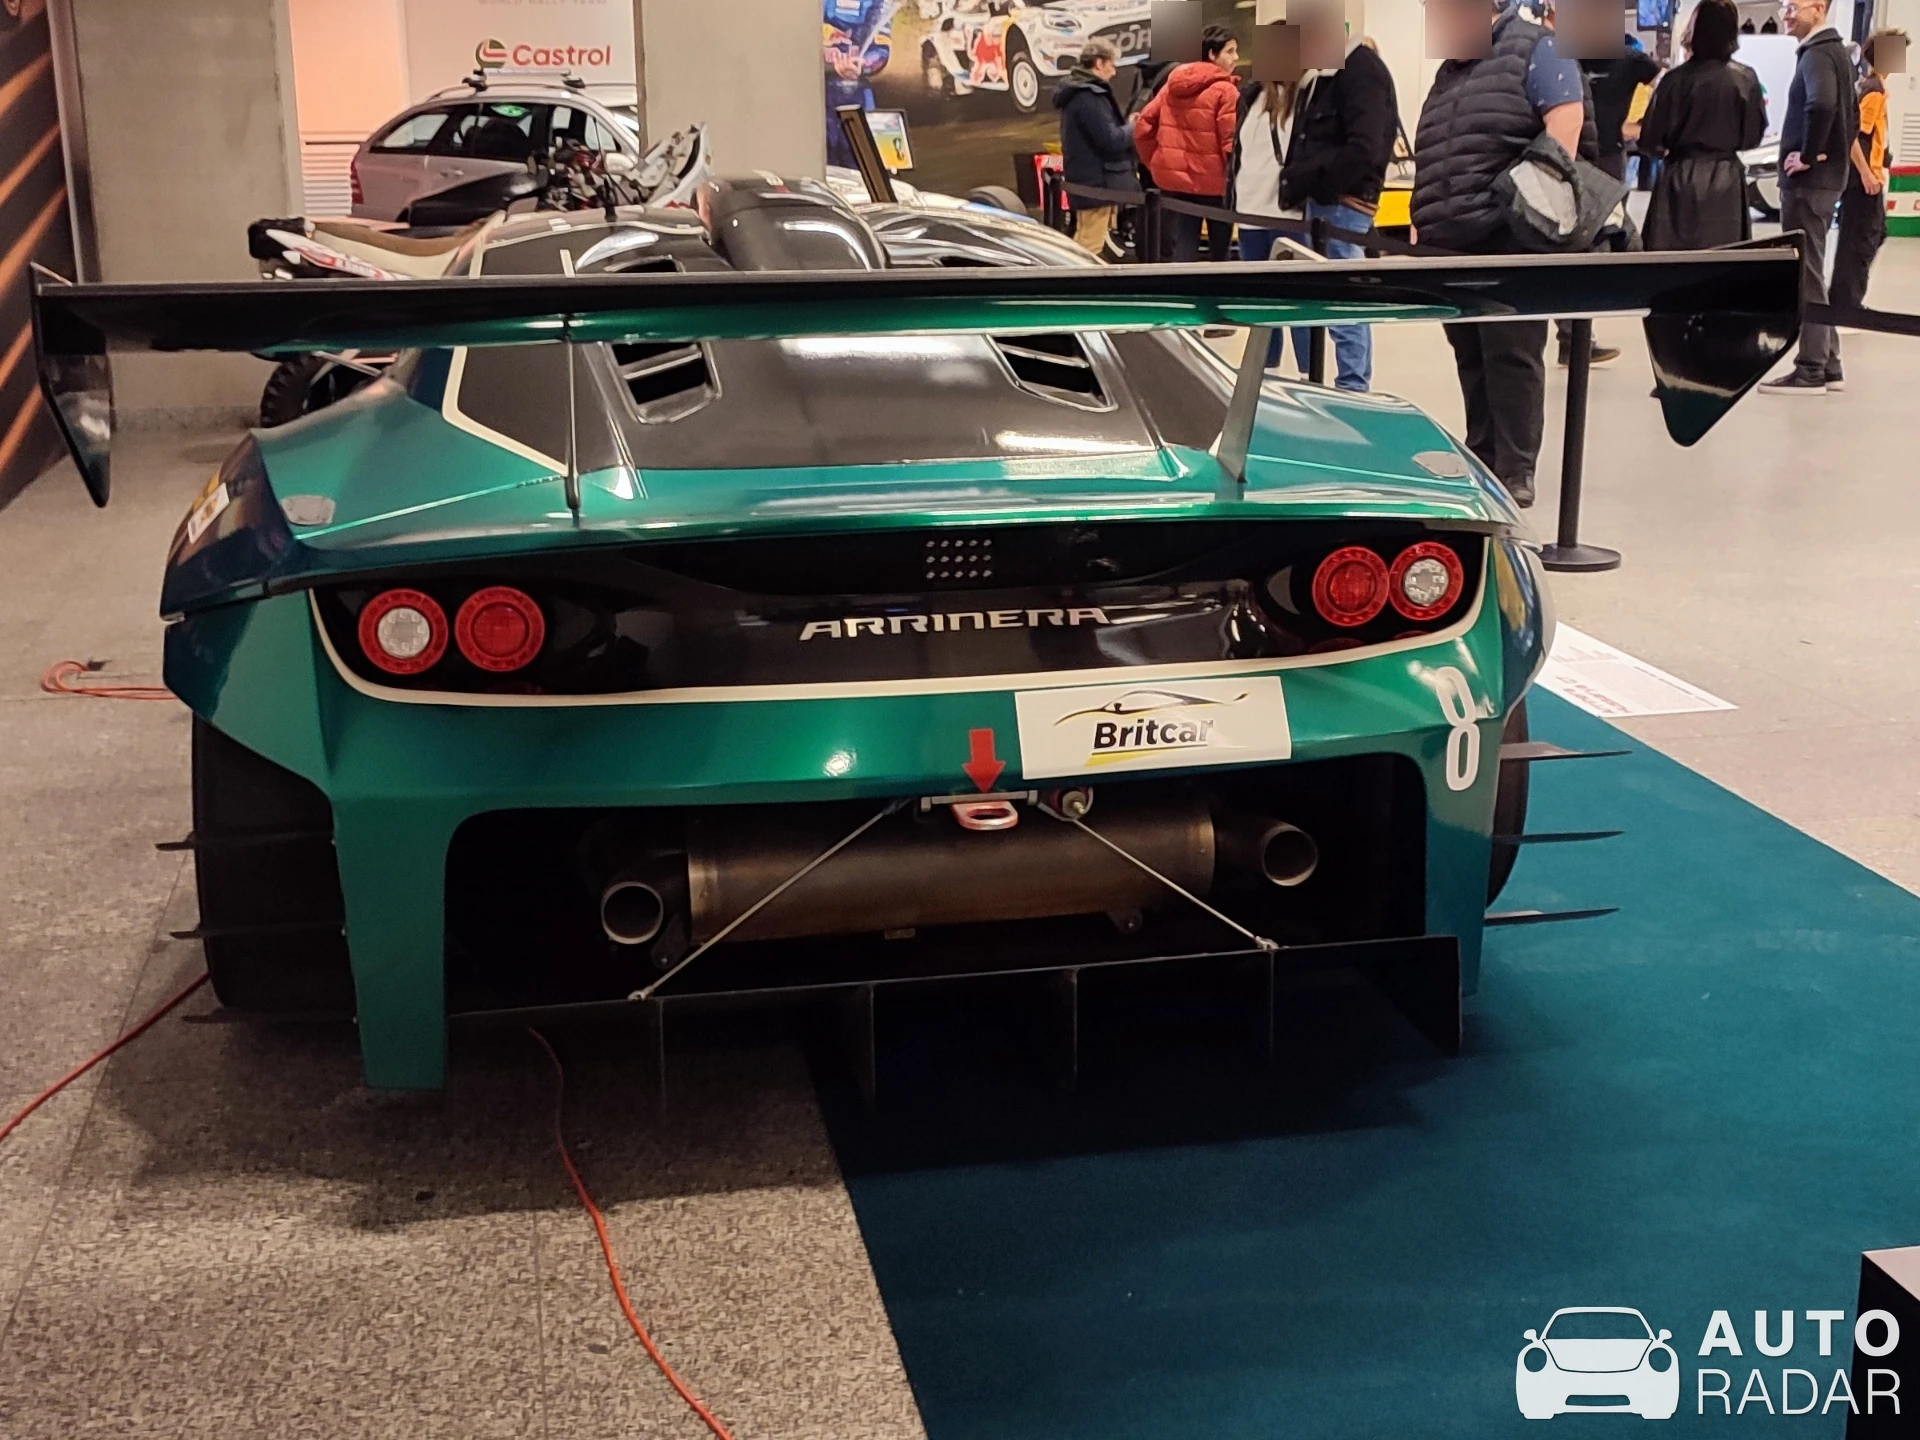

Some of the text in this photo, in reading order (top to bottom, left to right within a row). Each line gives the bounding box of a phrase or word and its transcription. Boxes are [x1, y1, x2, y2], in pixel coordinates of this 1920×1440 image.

[513, 45, 611, 66] Castrol
[800, 607, 1111, 641] ARRINERA
[1093, 718, 1215, 749] Britcar
[1436, 666, 1480, 791] 8
